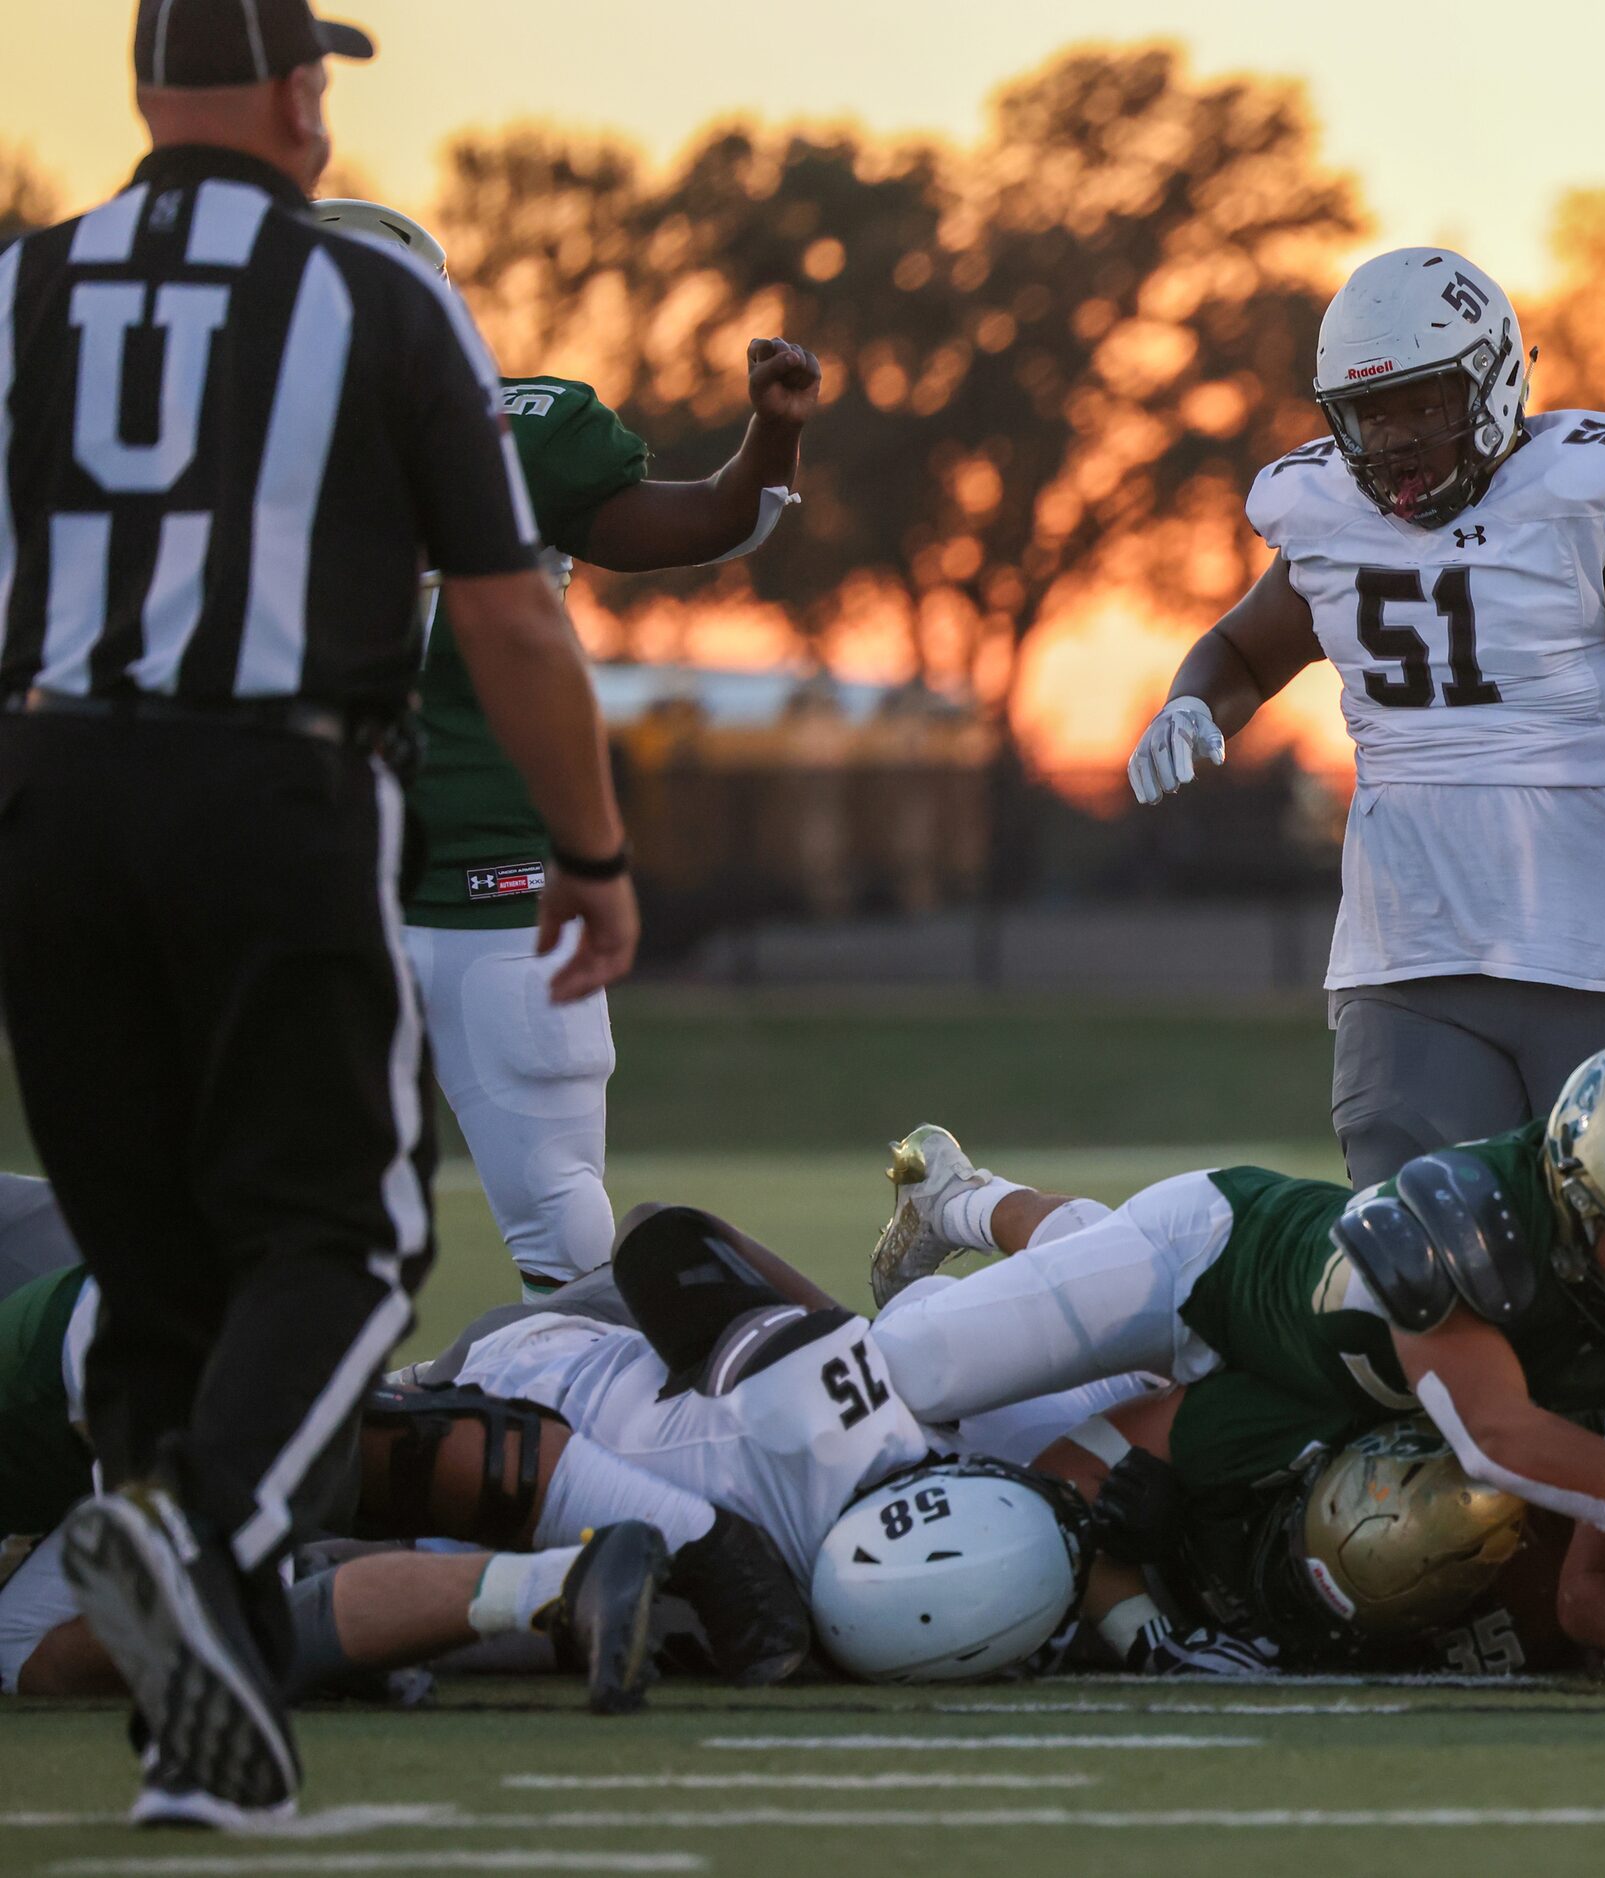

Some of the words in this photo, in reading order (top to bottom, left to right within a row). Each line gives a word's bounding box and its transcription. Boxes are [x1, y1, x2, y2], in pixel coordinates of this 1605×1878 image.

[1441, 271, 1490, 324] 51
[68, 281, 231, 493] U
[1347, 360, 1394, 380] Riddell
[1354, 565, 1504, 708] 51
[821, 1340, 890, 1431] 15
[880, 1487, 951, 1540] 58
